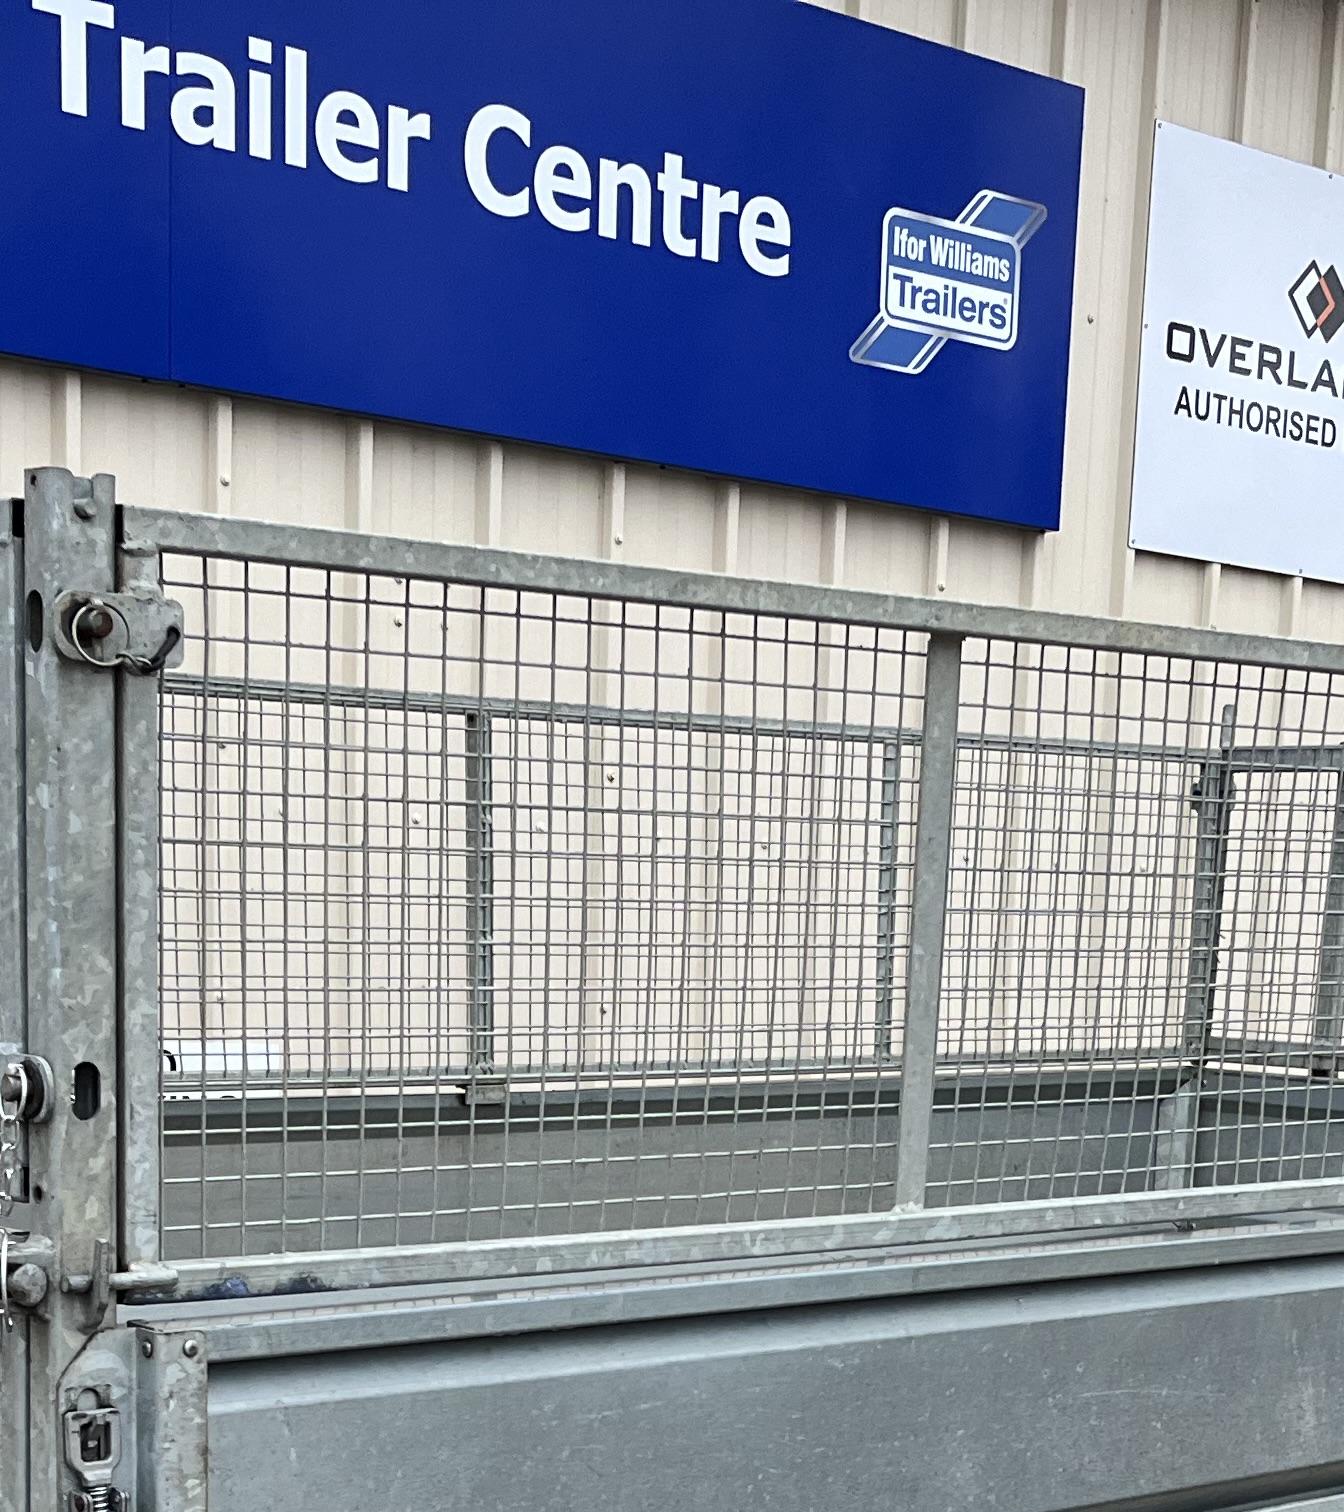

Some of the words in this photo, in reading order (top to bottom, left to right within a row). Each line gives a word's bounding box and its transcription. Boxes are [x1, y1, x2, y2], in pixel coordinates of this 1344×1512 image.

[32, 0, 431, 192] Trailer
[463, 104, 792, 277] Centre
[893, 226, 927, 262] Ifor
[929, 234, 1011, 282] Williams
[892, 272, 1007, 330] Trailers
[1173, 385, 1337, 448] AUTHORISED
